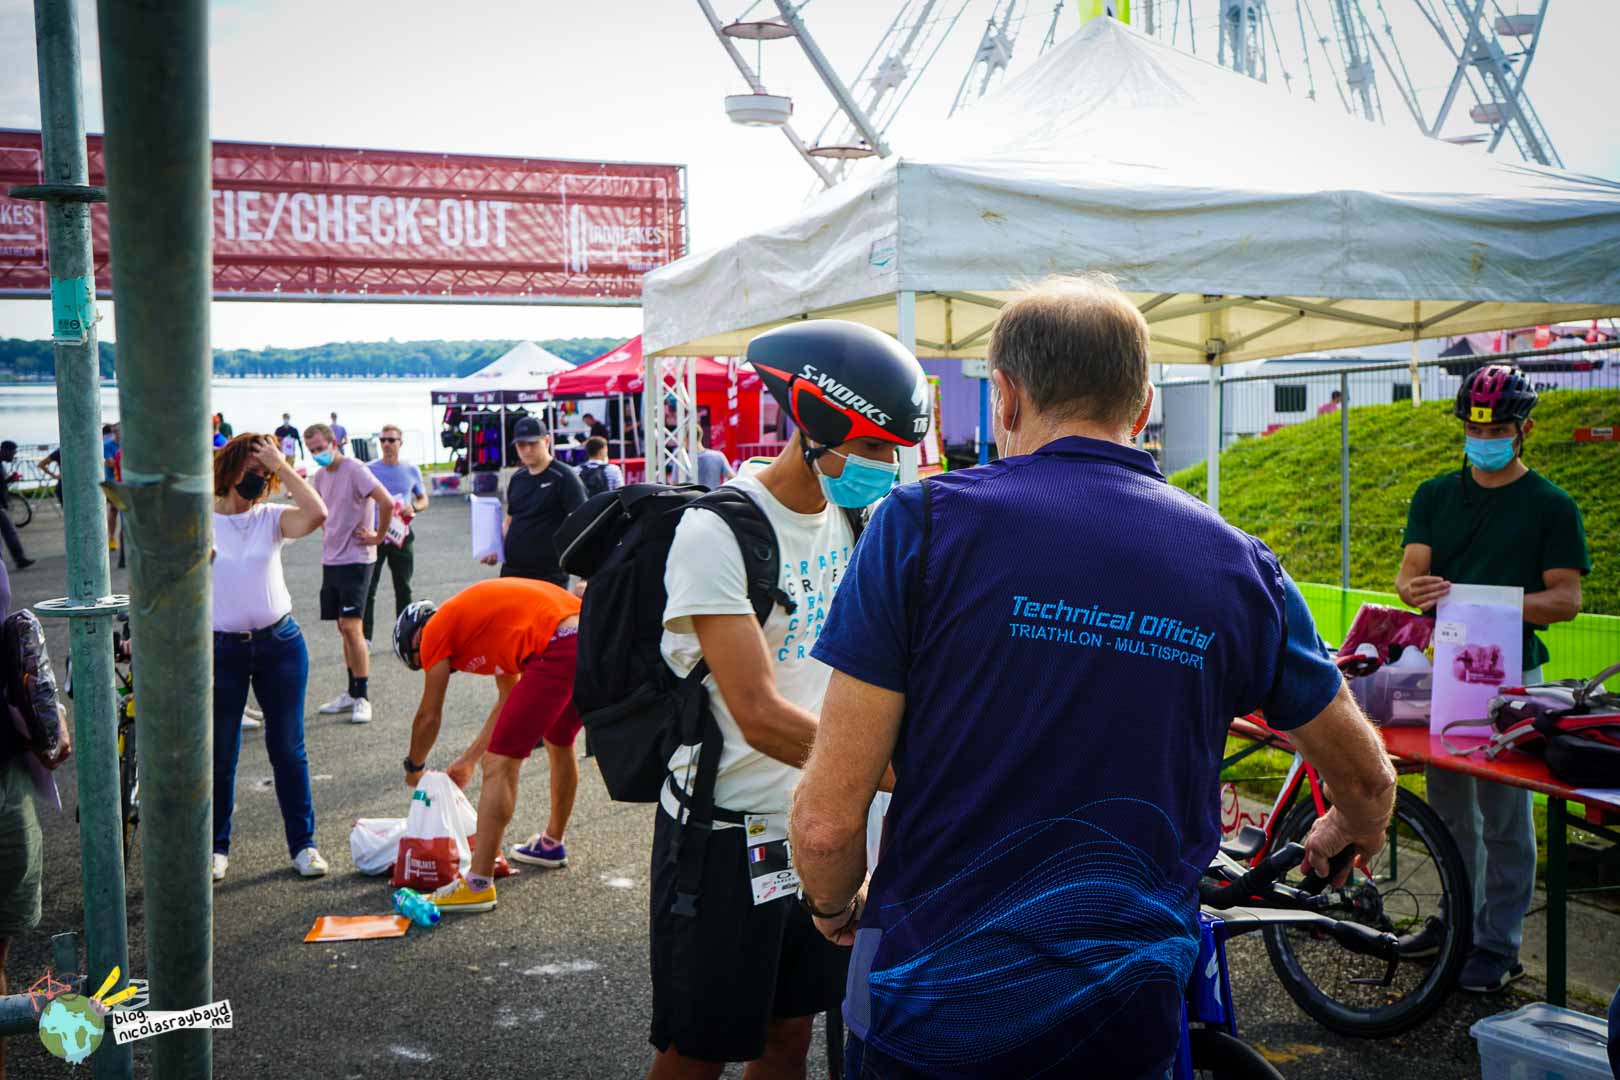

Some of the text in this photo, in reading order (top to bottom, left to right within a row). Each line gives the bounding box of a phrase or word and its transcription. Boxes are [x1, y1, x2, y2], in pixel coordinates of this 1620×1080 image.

[798, 364, 892, 426] S-WORKS
[1009, 623, 1102, 648] TRIATHLON
[1114, 637, 1204, 670] MULTISPORT
[1012, 595, 1216, 650] Technical Official
